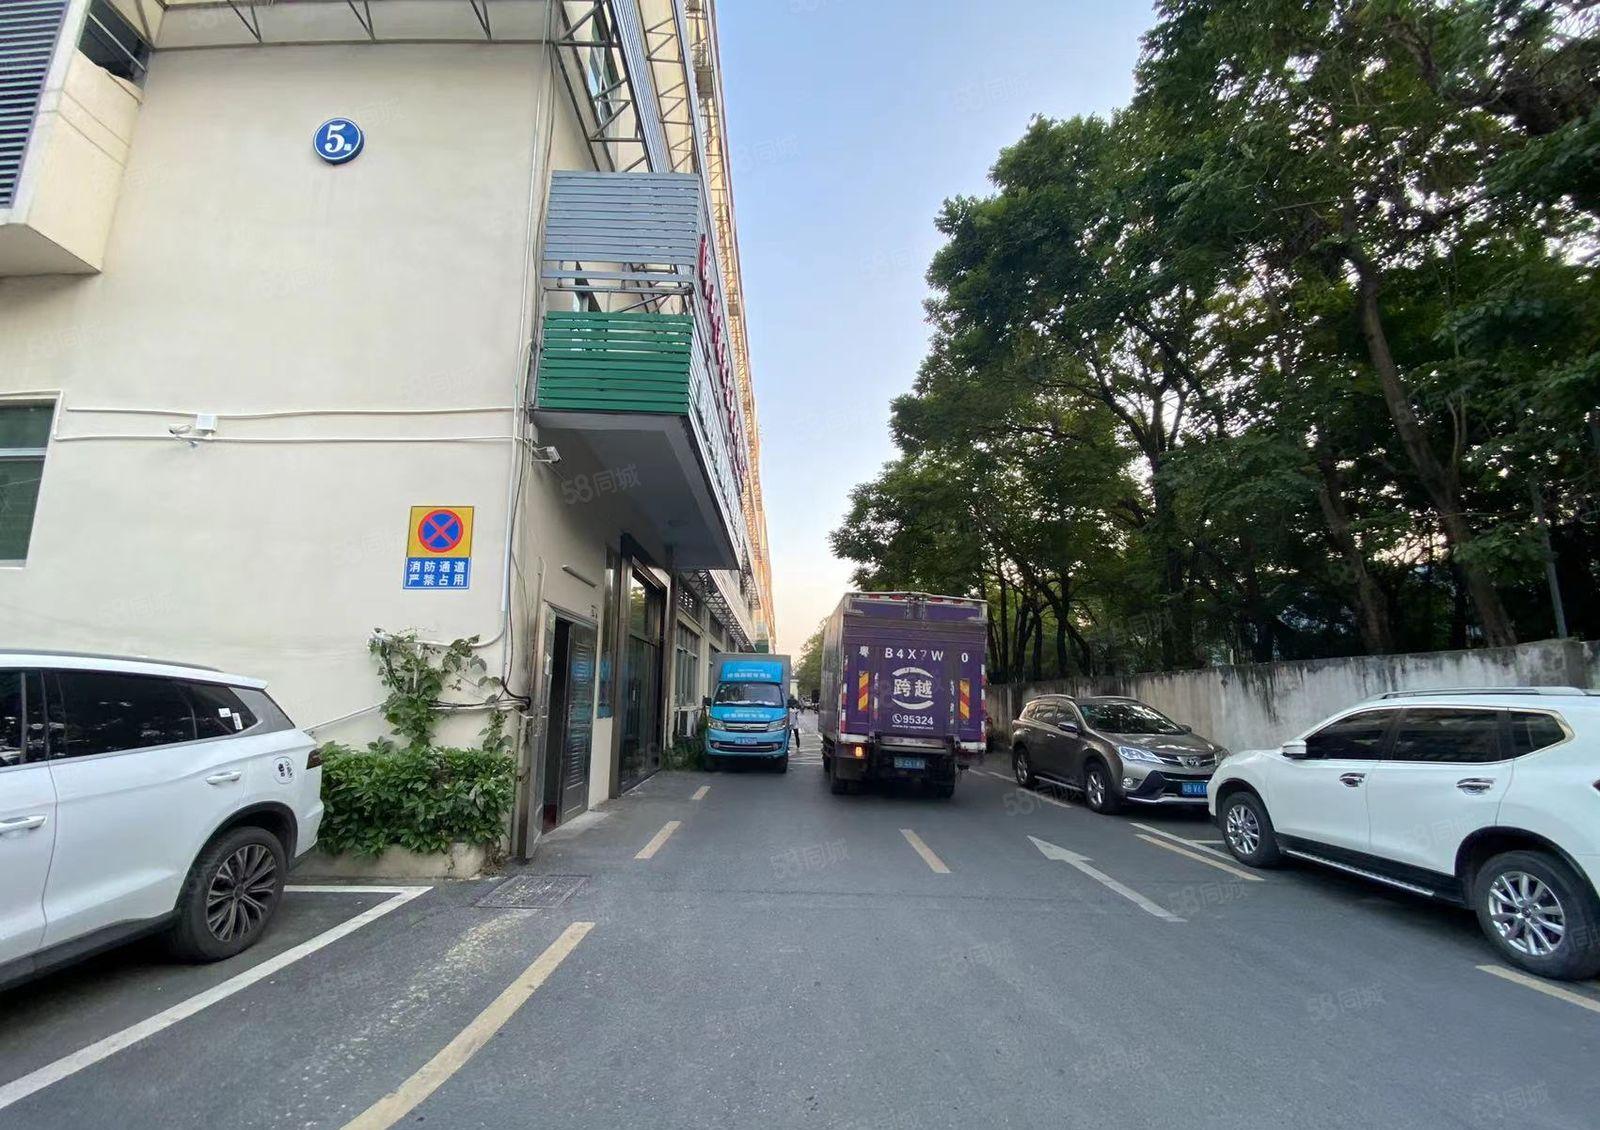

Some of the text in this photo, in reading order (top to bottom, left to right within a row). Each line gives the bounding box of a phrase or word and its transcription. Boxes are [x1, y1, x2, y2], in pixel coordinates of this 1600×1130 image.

[409, 561, 466, 573] 消防通道
[408, 574, 464, 586] 严禁占用
[893, 678, 933, 699] 跨越
[902, 714, 934, 726] 95324
